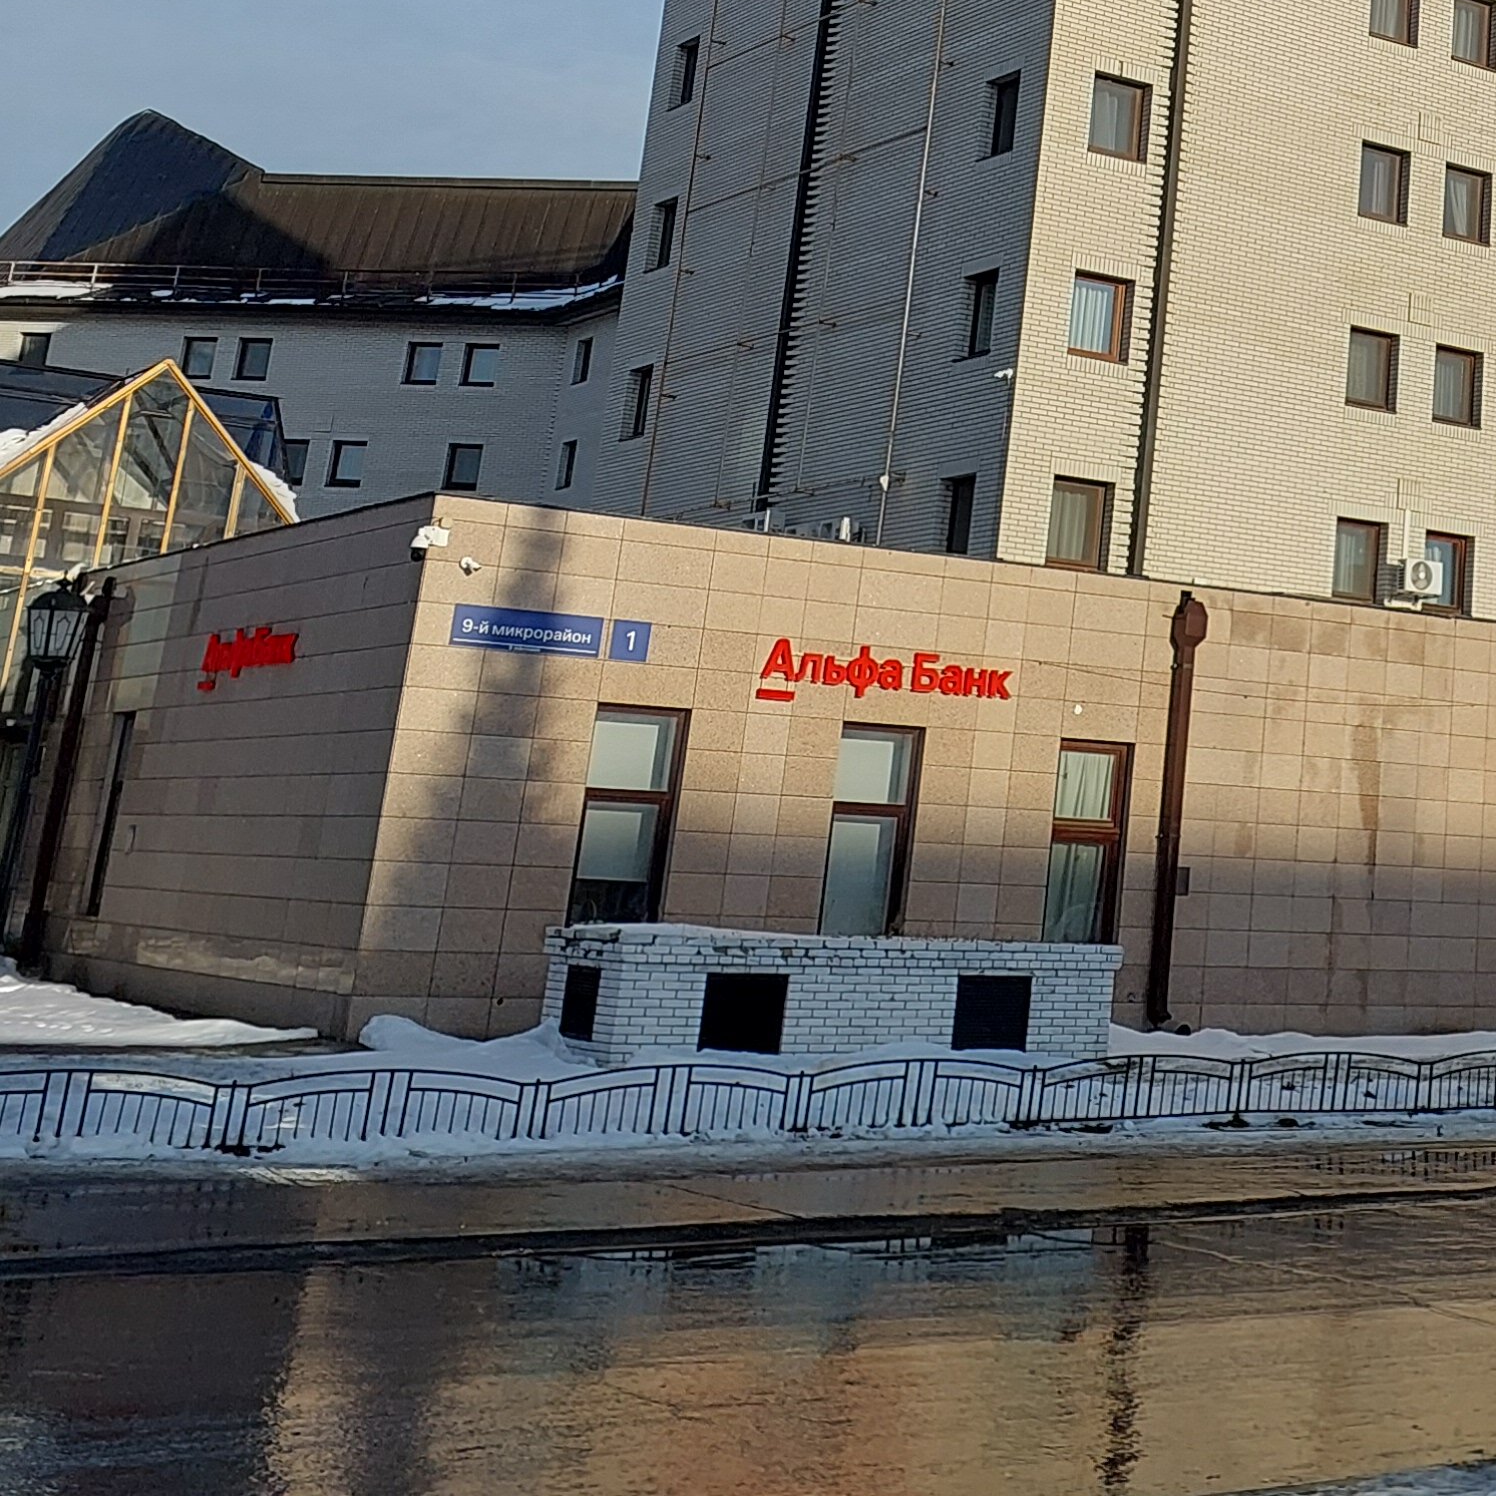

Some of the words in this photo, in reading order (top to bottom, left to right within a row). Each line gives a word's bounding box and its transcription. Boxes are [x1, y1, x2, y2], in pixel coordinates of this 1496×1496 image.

[461, 618, 489, 635] 9-й
[491, 623, 592, 645] микрорайон
[626, 630, 636, 652] 1
